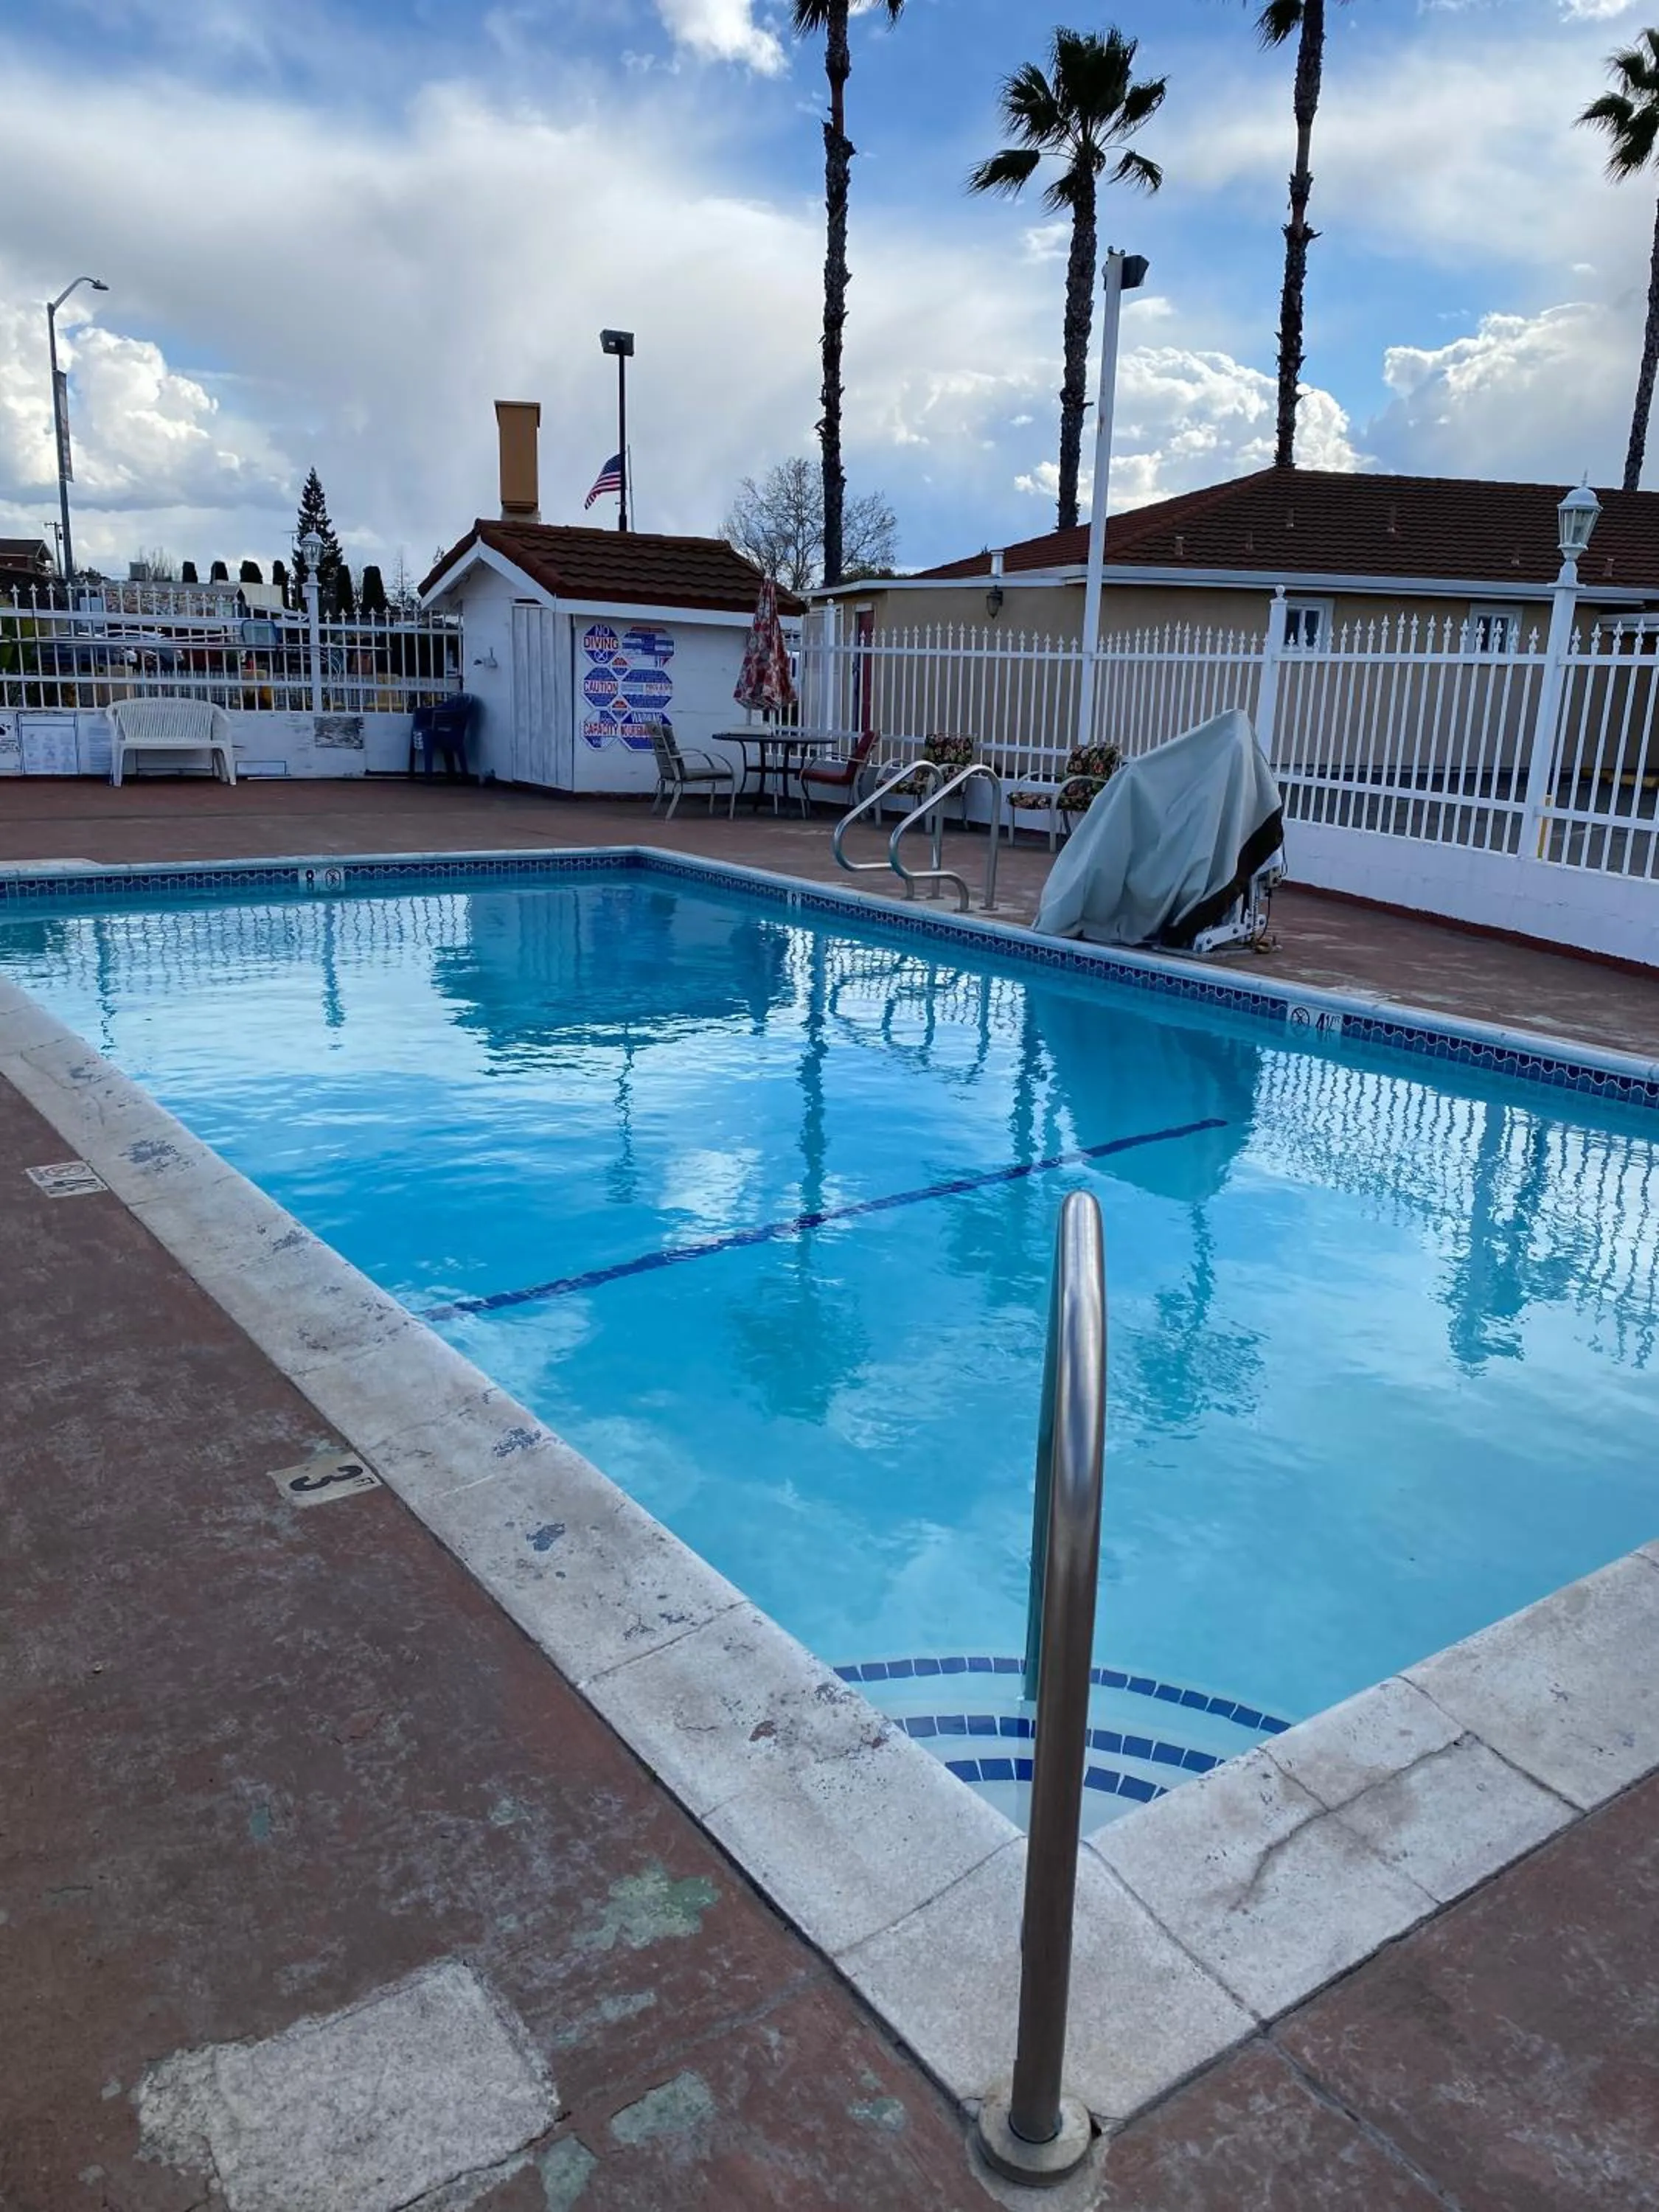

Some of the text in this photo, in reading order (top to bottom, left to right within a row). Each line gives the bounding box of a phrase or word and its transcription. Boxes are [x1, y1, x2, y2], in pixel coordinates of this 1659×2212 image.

[595, 624, 611, 636] NO
[583, 636, 619, 650] DIVING
[583, 680, 619, 692] CAUTION
[583, 723, 619, 735] CAPACITY
[290, 1465, 363, 1491] 3
